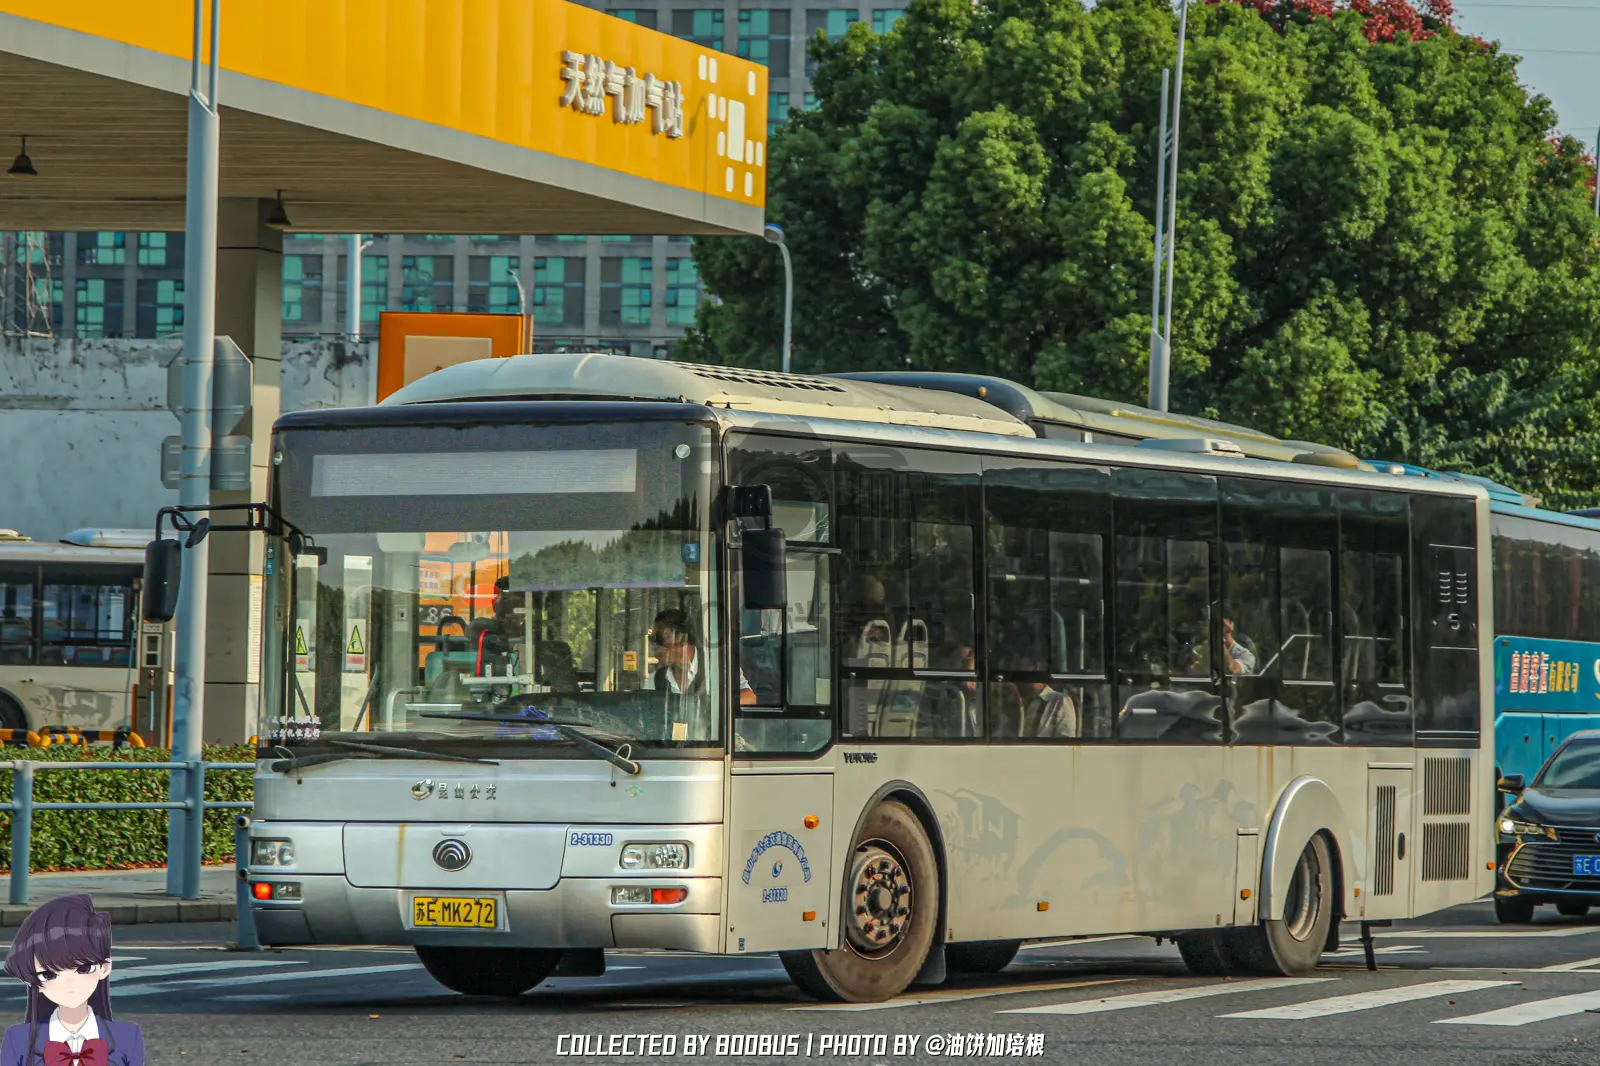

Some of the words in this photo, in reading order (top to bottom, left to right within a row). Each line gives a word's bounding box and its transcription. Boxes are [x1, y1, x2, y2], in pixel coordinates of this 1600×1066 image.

[560, 50, 685, 138] 天然气加气站
[843, 751, 878, 763] YUTONG
[438, 782, 496, 800] 昆山公交
[571, 832, 613, 846] 2-31330
